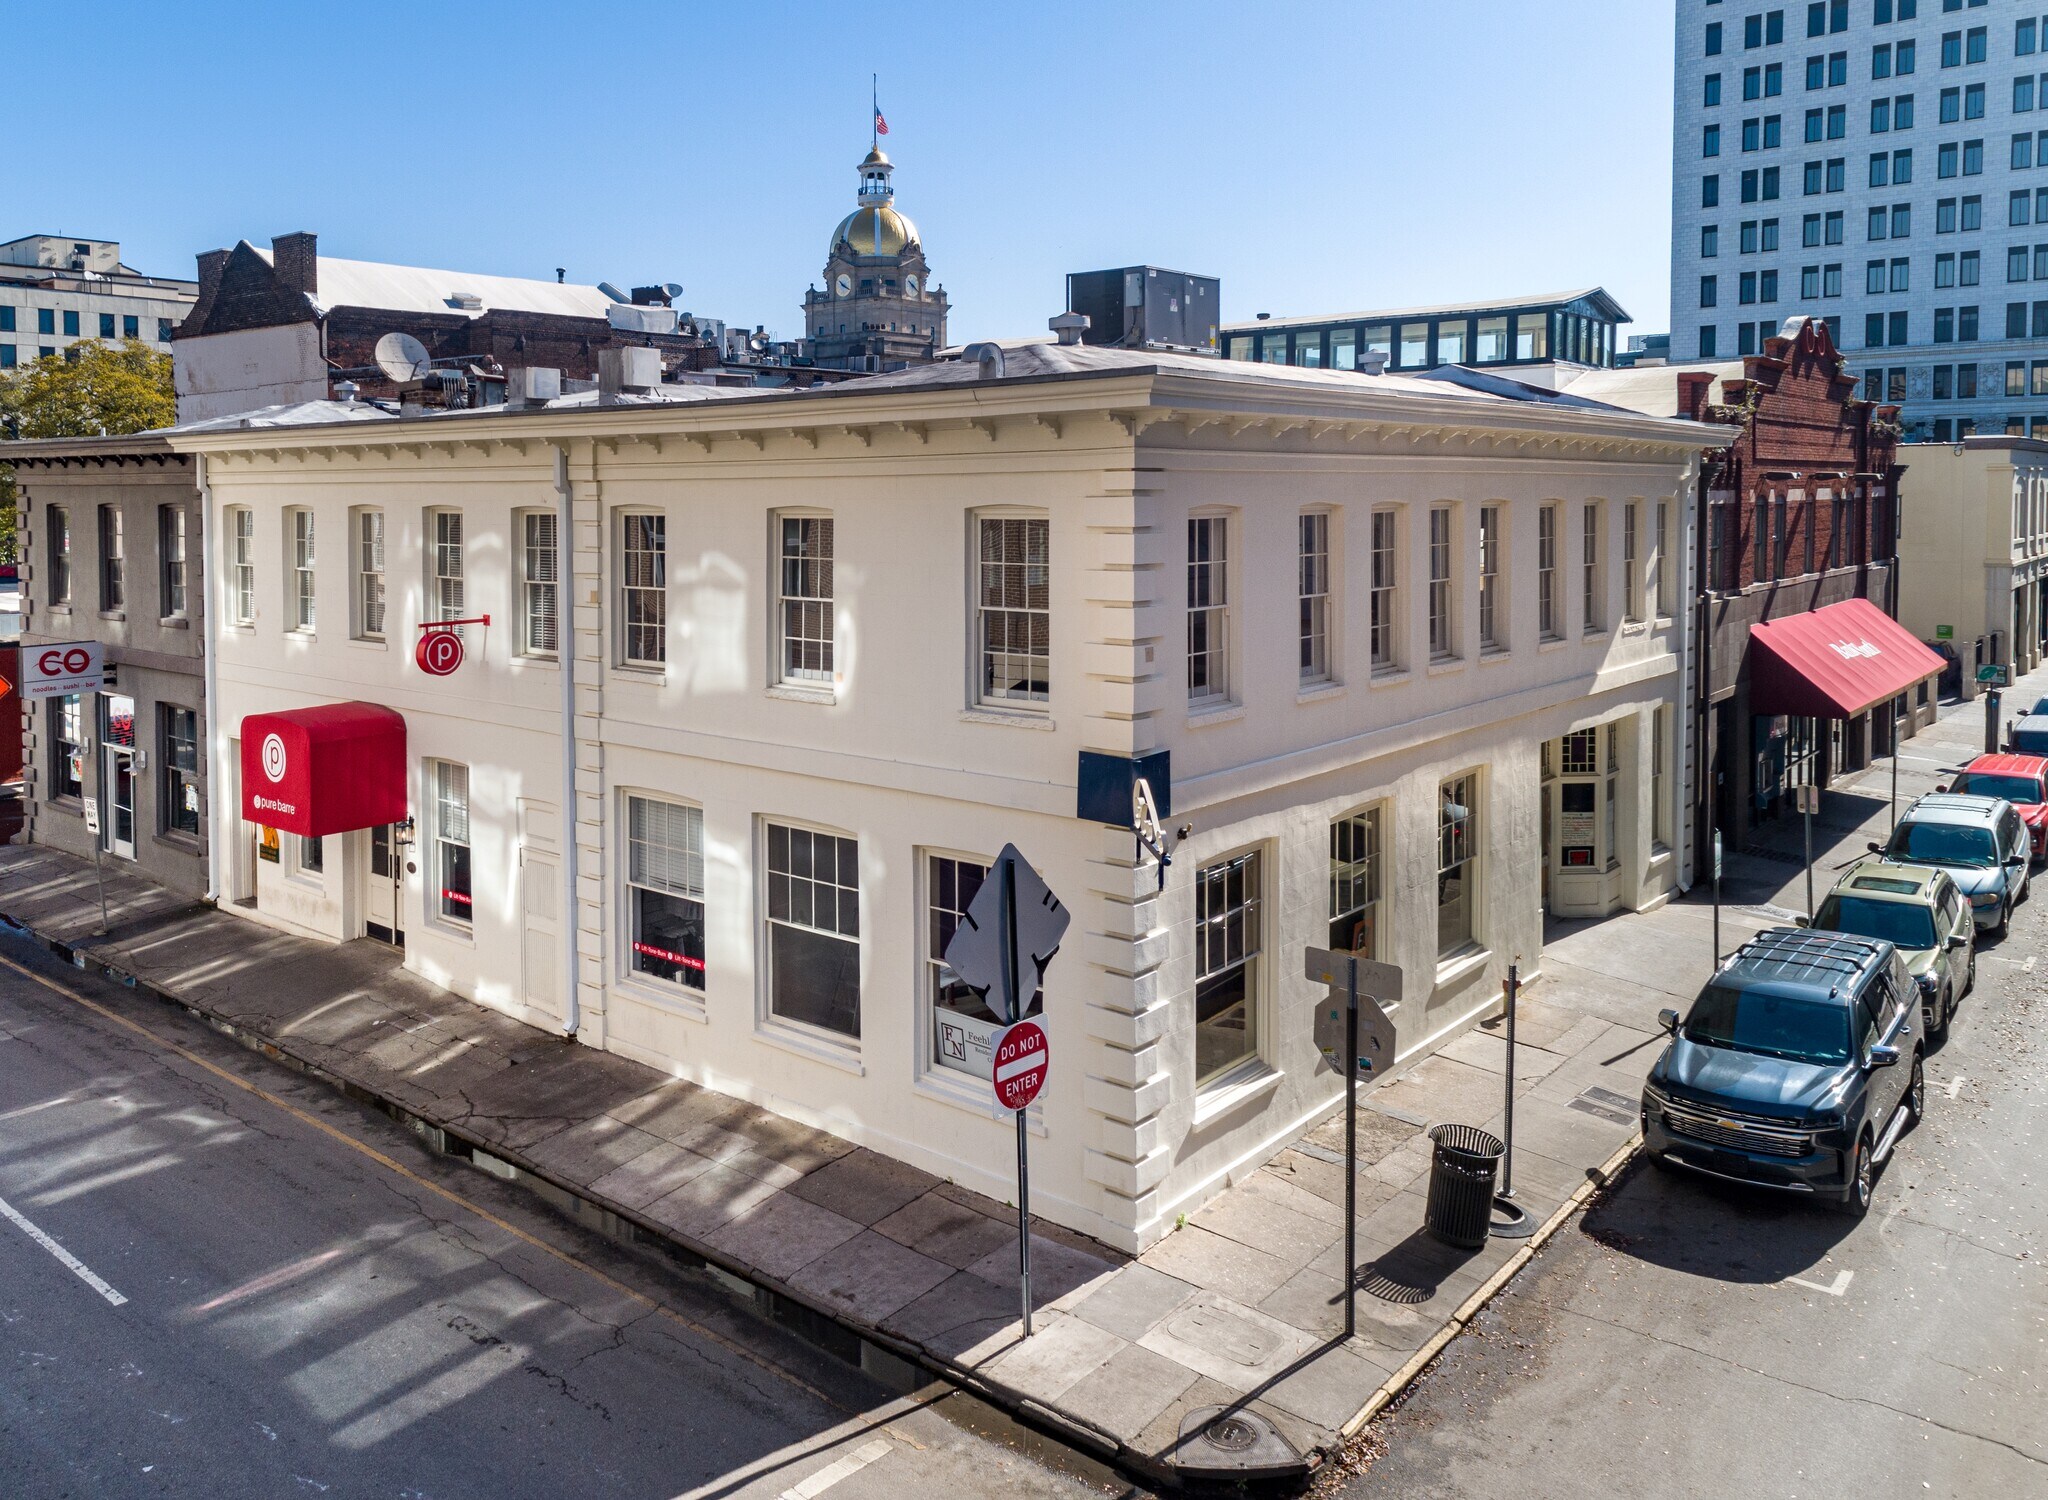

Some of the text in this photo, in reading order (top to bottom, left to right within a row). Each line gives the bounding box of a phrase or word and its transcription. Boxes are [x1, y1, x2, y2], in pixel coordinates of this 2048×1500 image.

[39, 648, 91, 677] CO
[32, 685, 57, 693] noodles
[62, 682, 80, 690] sushi
[86, 800, 96, 810] ONE
[261, 797, 295, 815] pure barre
[87, 810, 97, 819] WAY
[968, 1031, 992, 1046] Feehl
[1001, 1043, 1016, 1061] DO
[1020, 1033, 1041, 1053] NOT
[1006, 1072, 1038, 1097] ENTER
